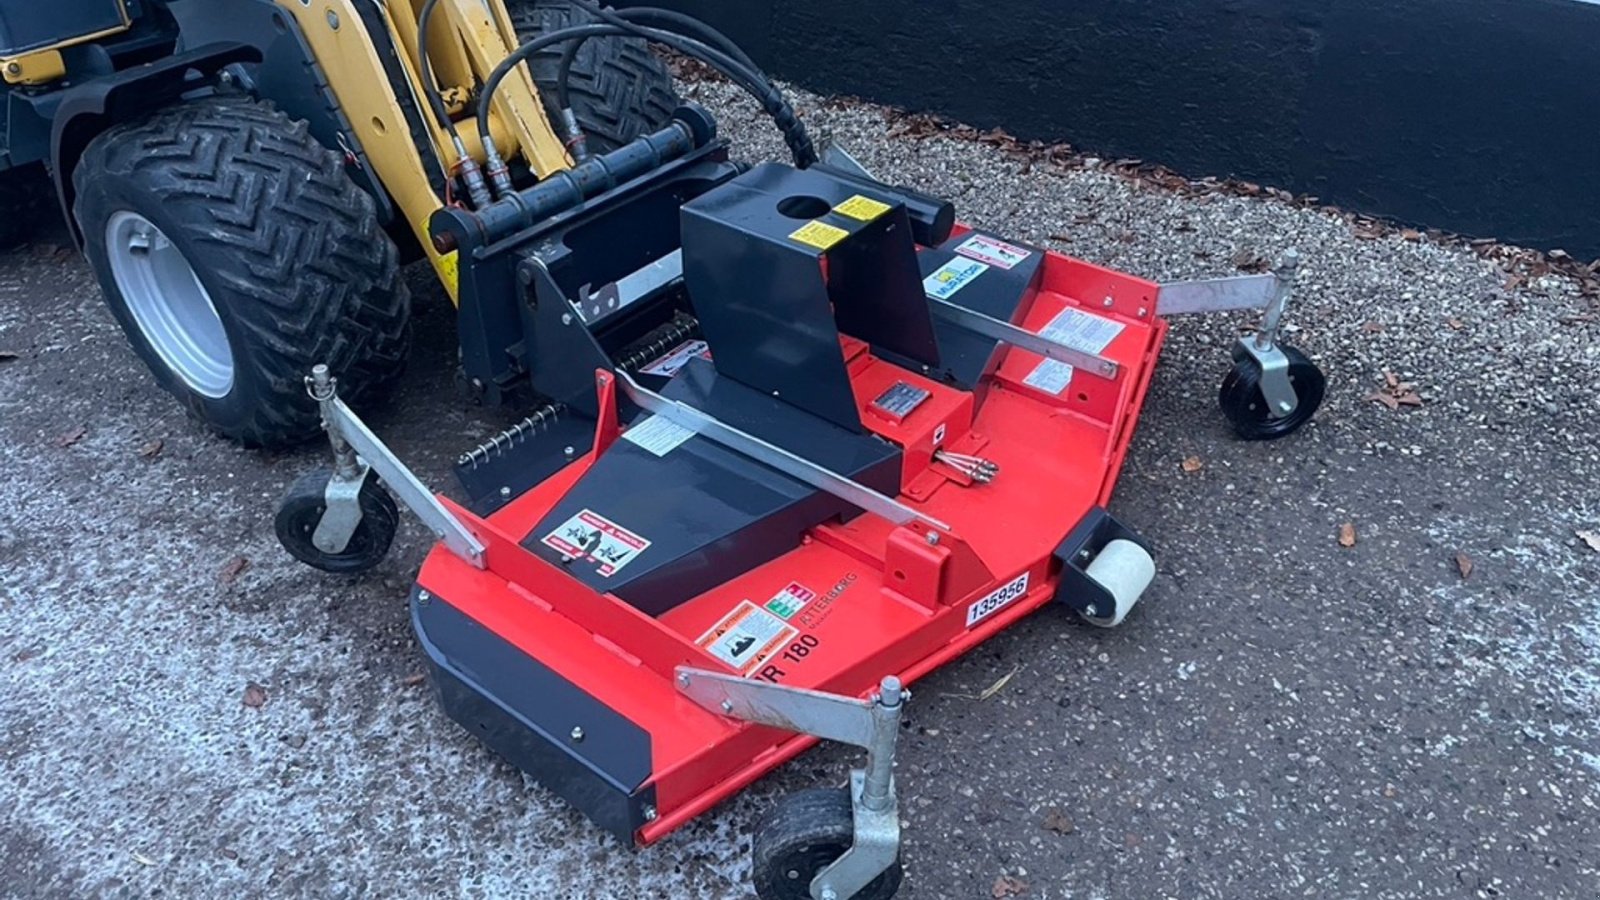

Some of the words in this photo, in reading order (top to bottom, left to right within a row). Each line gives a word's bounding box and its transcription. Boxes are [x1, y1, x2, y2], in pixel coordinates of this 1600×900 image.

[971, 576, 1026, 620] 135956
[754, 665, 786, 684] R
[783, 634, 819, 663] 180
